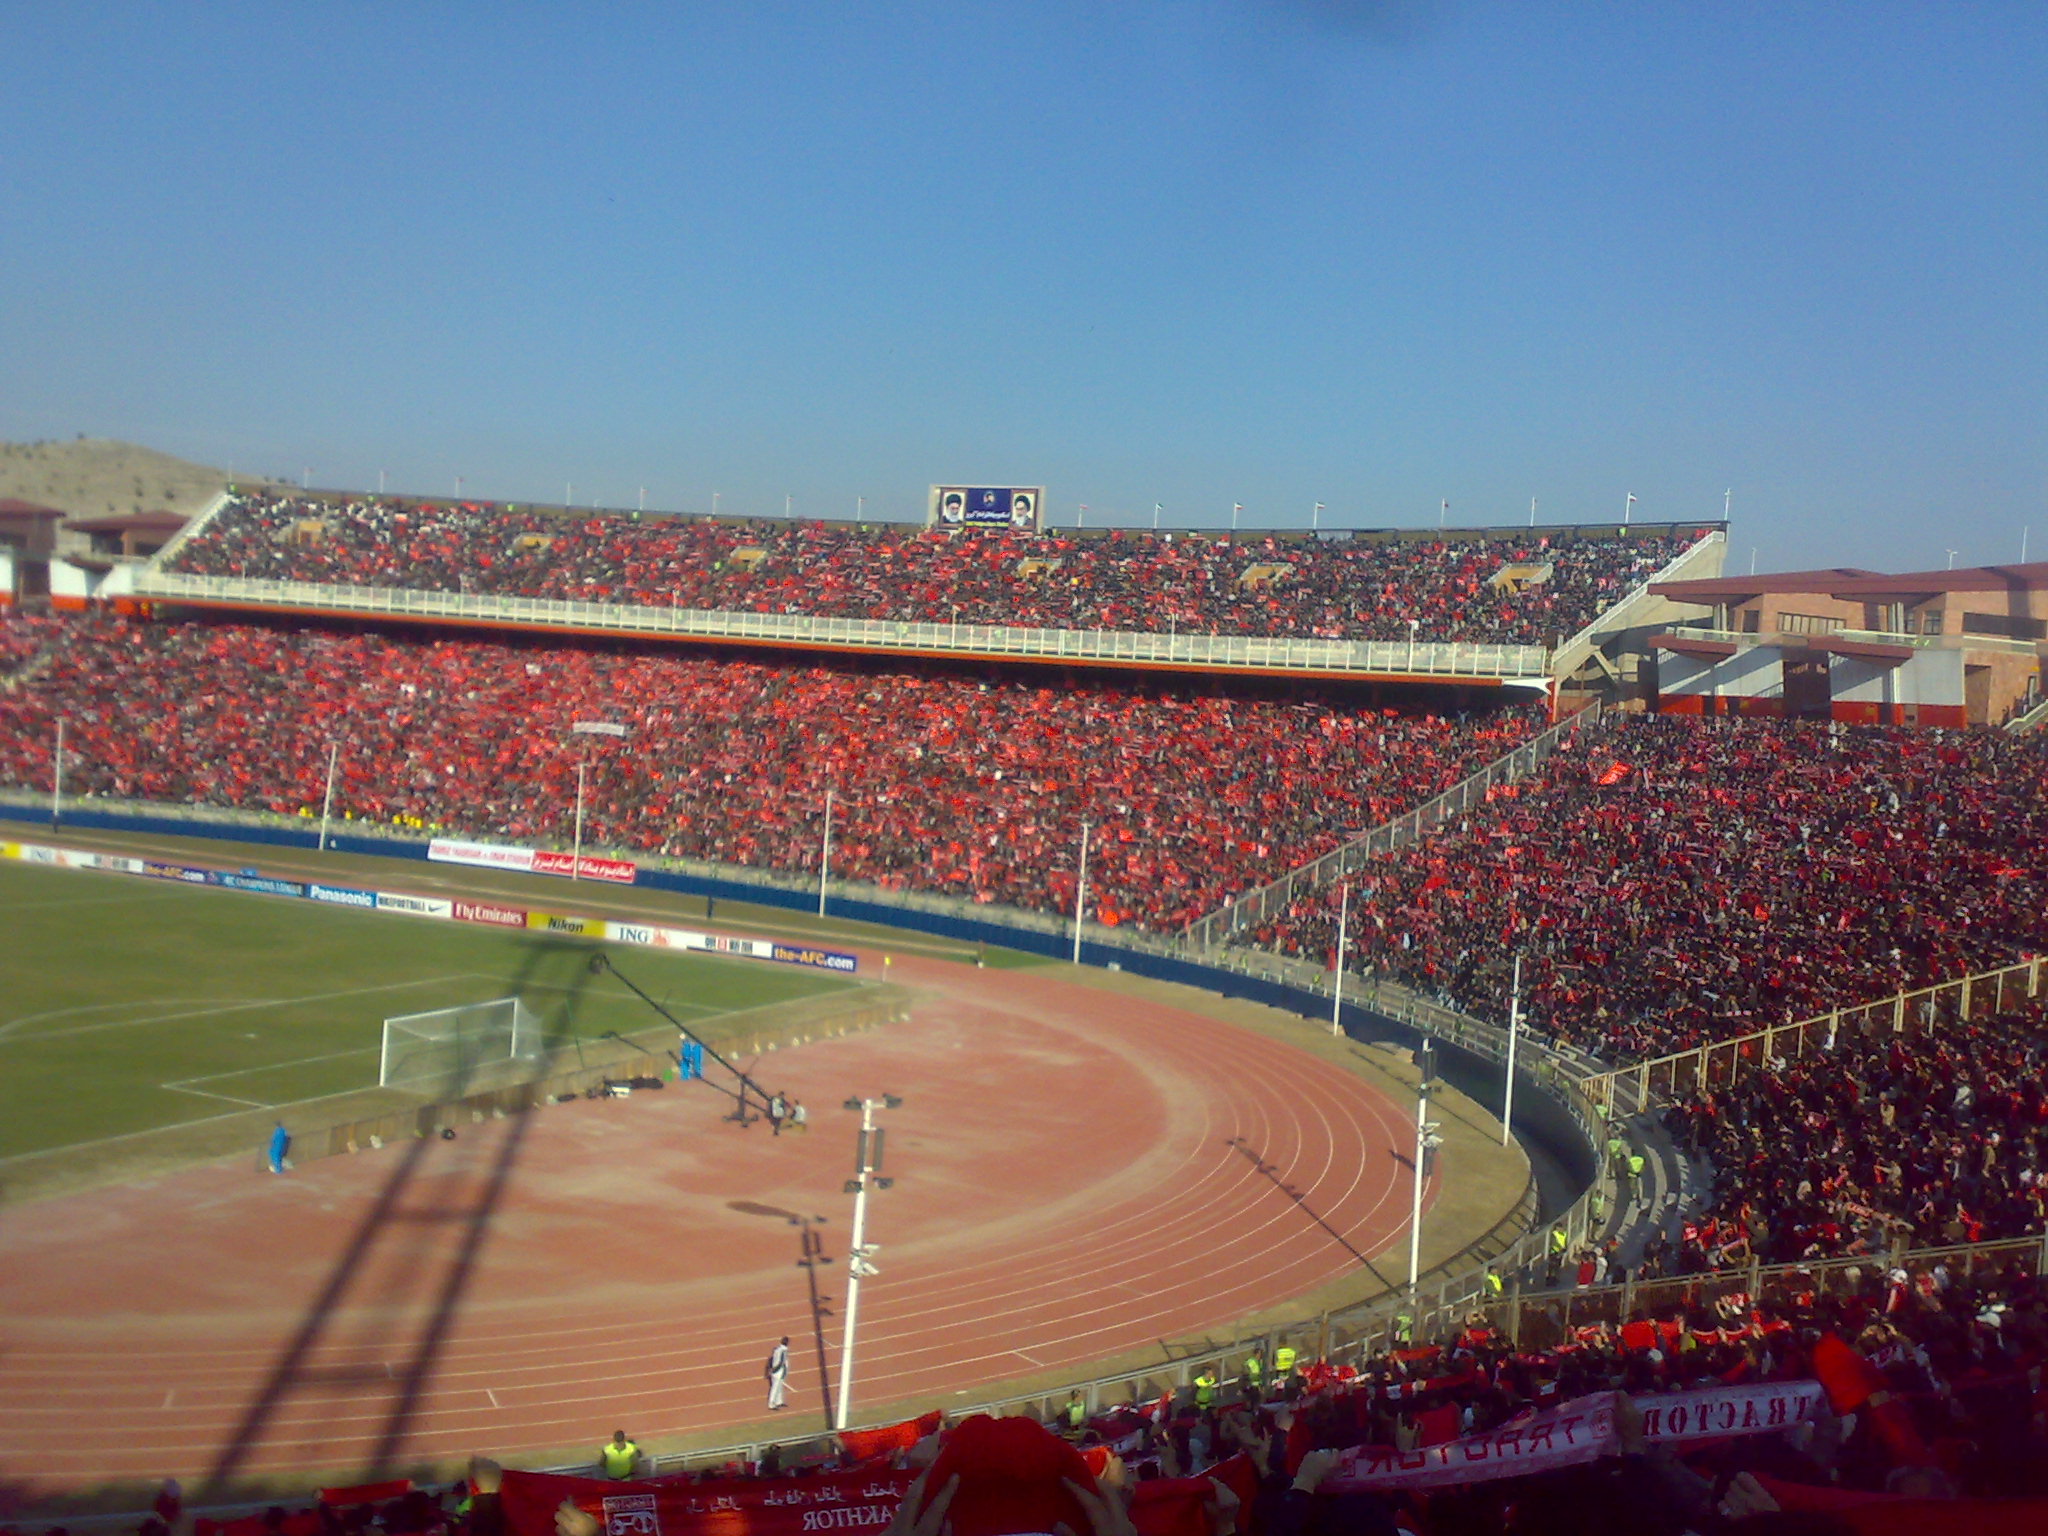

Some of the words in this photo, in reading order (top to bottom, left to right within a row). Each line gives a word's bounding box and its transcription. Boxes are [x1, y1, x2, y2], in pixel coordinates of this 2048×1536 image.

[310, 884, 372, 907] Panasonic
[475, 905, 523, 925] Emirates
[547, 916, 584, 933] Nikon
[618, 927, 649, 943] ING
[774, 946, 854, 971] the-AFC.com
